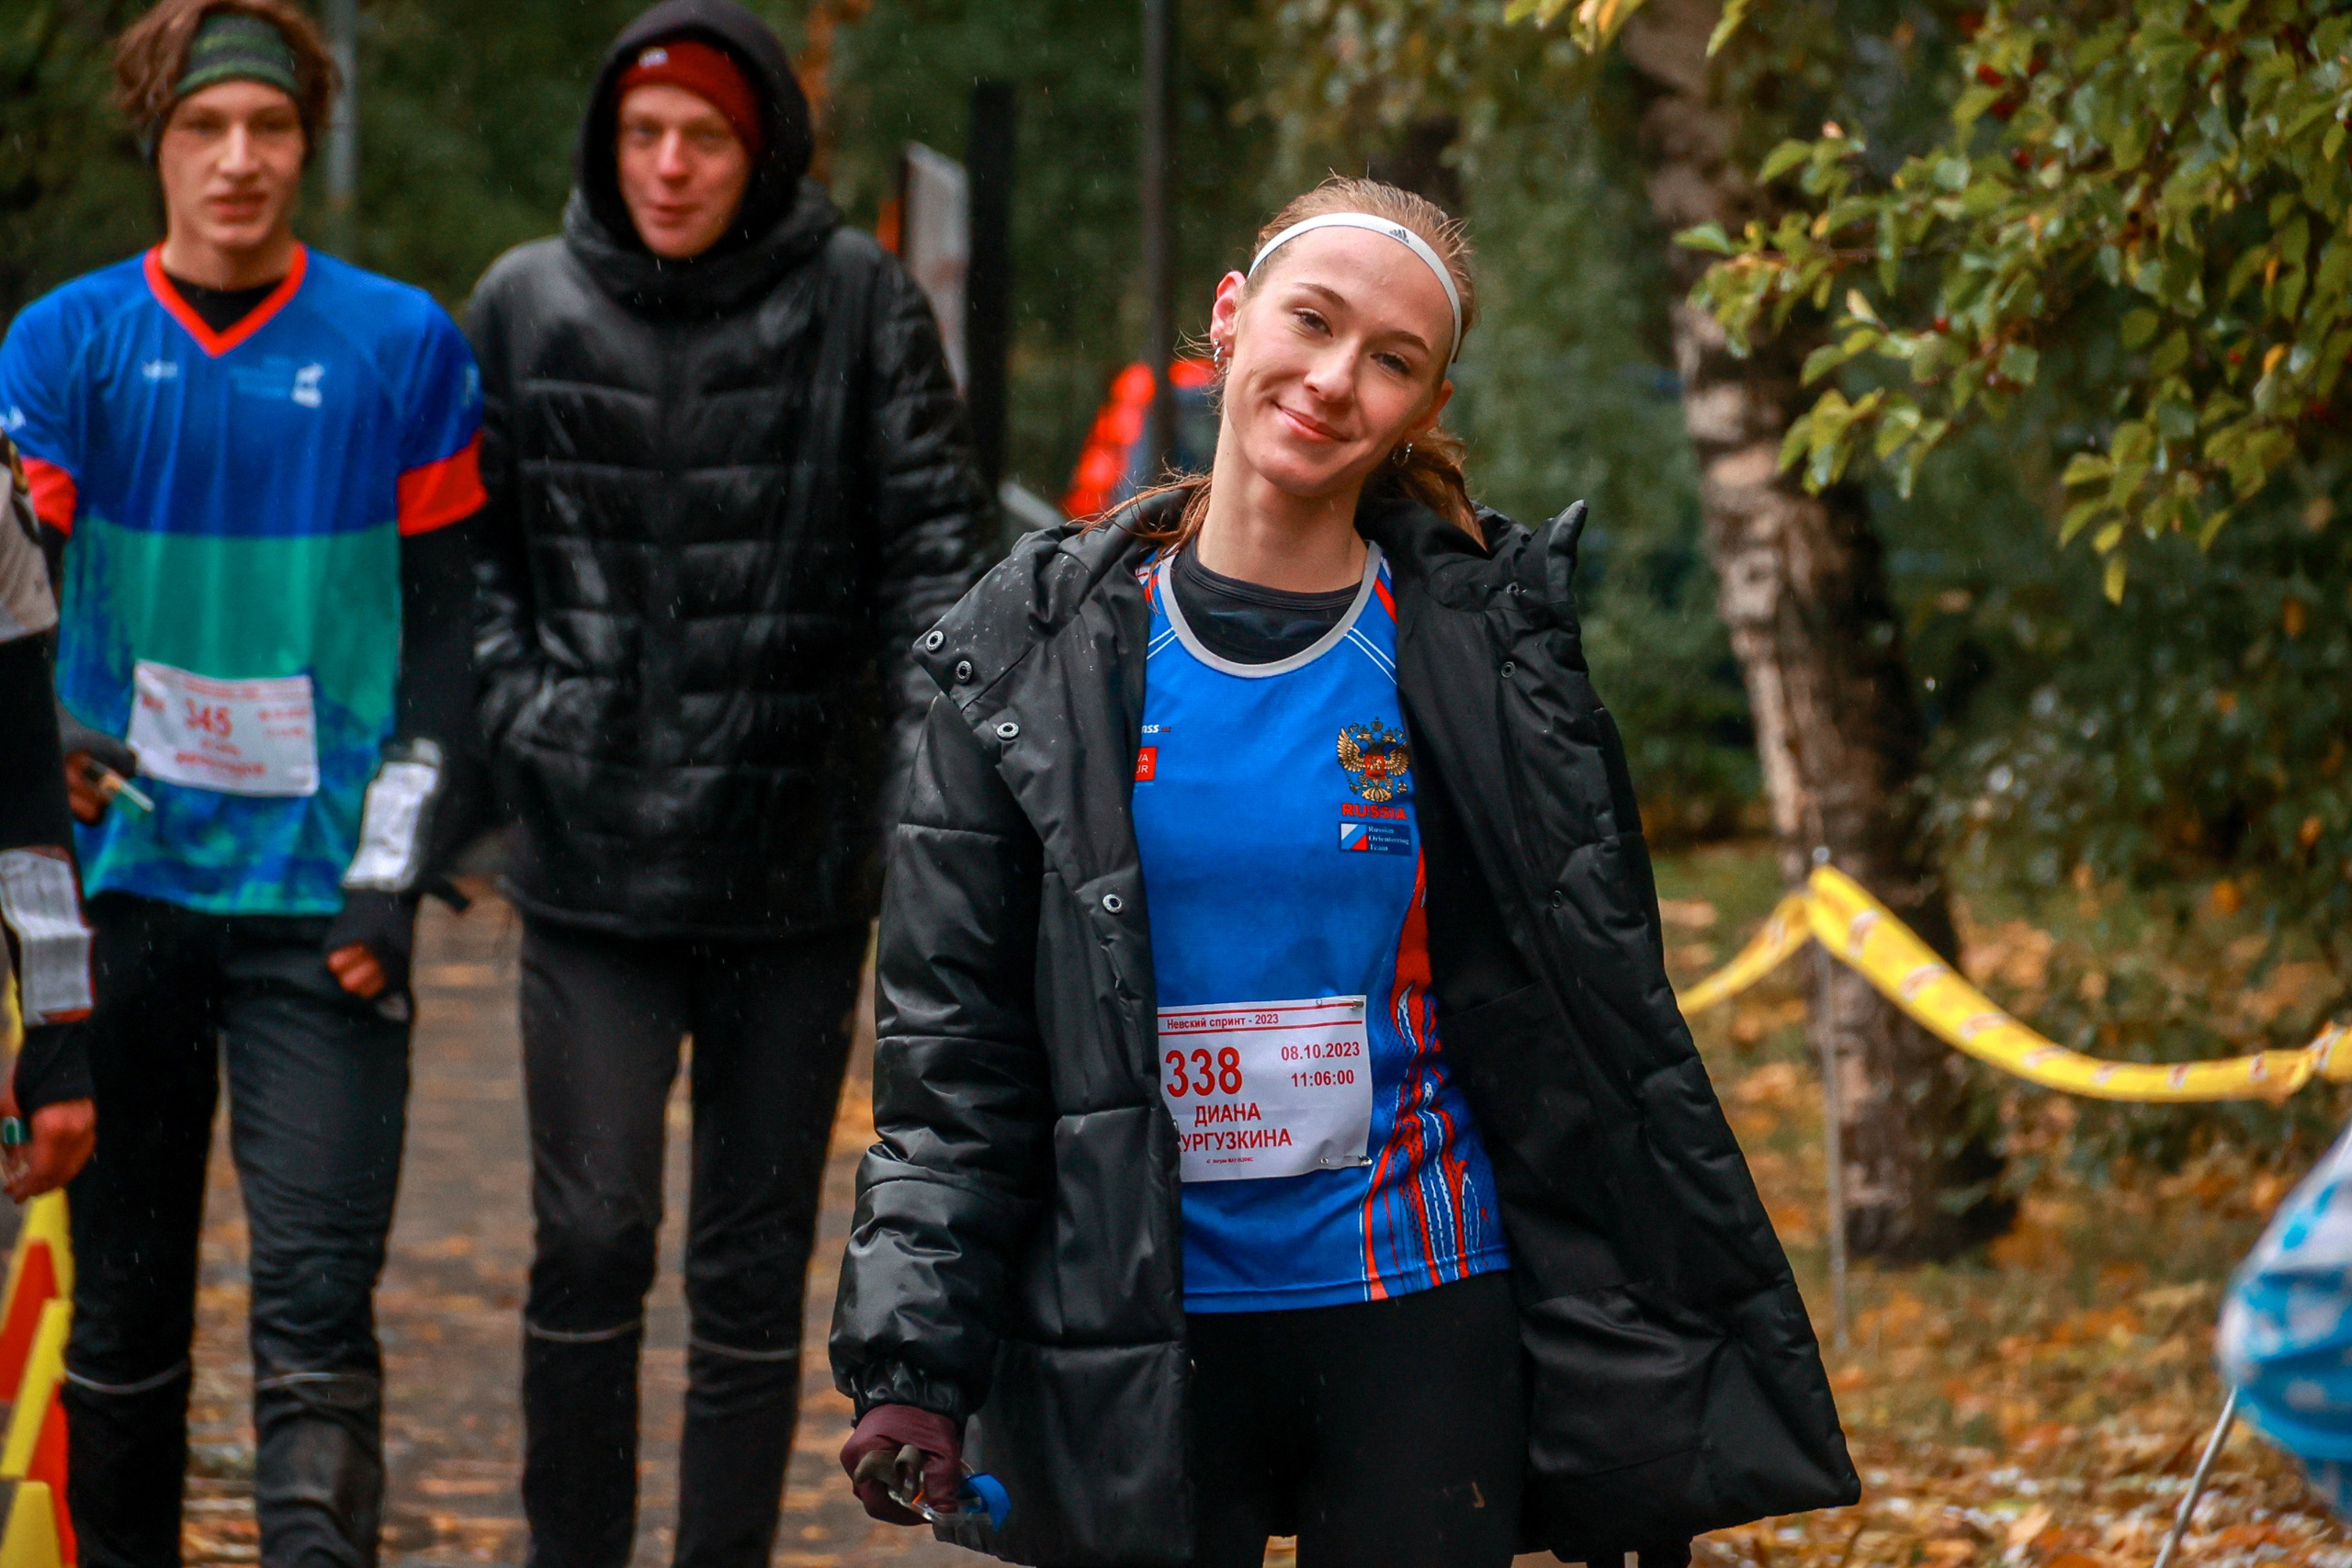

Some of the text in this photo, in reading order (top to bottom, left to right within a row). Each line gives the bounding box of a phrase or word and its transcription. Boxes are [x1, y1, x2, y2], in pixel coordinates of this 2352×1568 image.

[1341, 803, 1408, 820] RUSSIA
[1368, 826, 1394, 834] Russian
[1368, 834, 1409, 845] Orienteering
[1166, 1018, 1207, 1030] Невский
[1209, 1016, 1247, 1028] спринт
[1255, 1013, 1279, 1024] 2023
[1165, 1042, 1361, 1098] 338 08.10.2023
[1291, 1069, 1354, 1088] 11:06:00
[1194, 1102, 1261, 1128] ДИАНА
